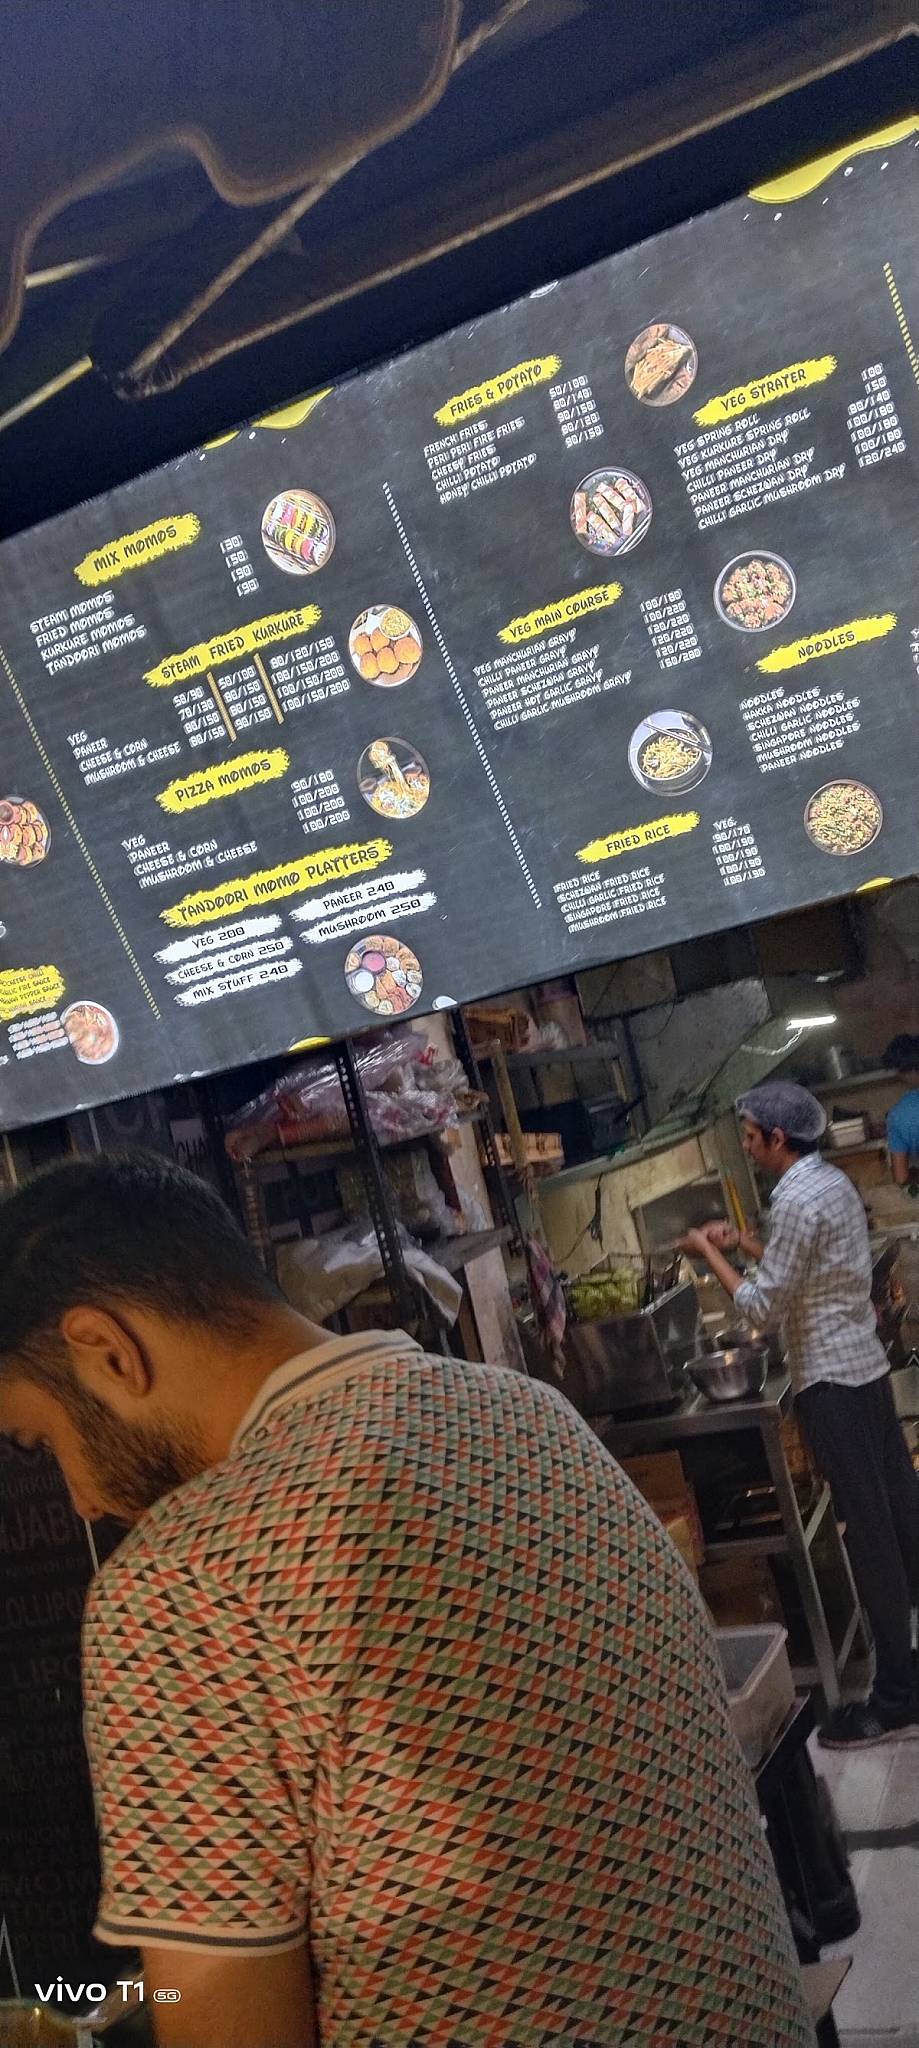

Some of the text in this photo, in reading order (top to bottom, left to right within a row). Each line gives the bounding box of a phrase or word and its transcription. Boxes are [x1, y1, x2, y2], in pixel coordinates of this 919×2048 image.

[721, 369, 806, 411] VEG STRATER
[861, 362, 883, 381] 100
[863, 375, 887, 394] 150
[450, 365, 541, 416] FRIES & POTATO
[423, 419, 488, 458] FRENCH FRIES
[427, 416, 525, 469] PERI PERI FIRE FRIES
[673, 413, 760, 456] VEG SPRING ROLL
[677, 407, 811, 469] VEG KURKURE SPRING ROLL
[430, 443, 496, 481] CHEESY FRIES
[681, 428, 789, 481] VEG MANCHURIAN DRY
[686, 447, 777, 493] CHILLI PANEER DRY
[856, 439, 906, 468] 120/240
[435, 456, 500, 492] CHILLI POTATO
[440, 453, 537, 504] HONEY CHILLI POTATO
[690, 446, 815, 506] PANEER MANCHURIAN DRY
[698, 462, 846, 530] CHILLI GARLIC MUSHROOM DRY
[94, 525, 176, 572] MIX MOMOS
[220, 534, 243, 554] 130
[225, 549, 248, 568] 150
[231, 563, 253, 582] 190
[236, 578, 259, 596] 190
[30, 590, 114, 634] STEAM MOMOS
[35, 606, 115, 648] FRIED MOMOS
[509, 590, 609, 637] VEG MAIN COURSE
[641, 600, 686, 624] 100/220
[647, 612, 690, 635] 120/220
[40, 614, 135, 661] KURKURE MOMOS
[45, 624, 147, 676] TANDOORI MOMOS
[161, 613, 304, 678] STEAM FRIED KURKURE
[472, 627, 576, 676] VEG MANCHURIAN GRAVY
[651, 623, 694, 647] 120/220
[655, 634, 698, 658] 120/220
[798, 631, 854, 658] NOODLES
[271, 650, 340, 685] 100/150/200
[276, 664, 345, 699] 100/150/200
[478, 644, 567, 687] CHILLI PANEER GRAVY
[481, 644, 599, 698] PANEER MANCHURIAN GRAVY
[281, 678, 351, 713] 100/150/200
[494, 670, 632, 730] CHILLI GARLIC MUSHROOM GRAVY
[739, 686, 785, 711] NOODLES
[742, 686, 821, 721] HAKKA NOODLES
[749, 696, 860, 742] CHILLI GARLIC NOODLES
[752, 710, 855, 752] SINGAPORE NOODLES
[66, 730, 88, 747] VEG
[72, 737, 108, 759] PANEER
[79, 738, 148, 772] CHEESE & CORN
[756, 720, 861, 763] MUSHROOM NOODLES
[84, 741, 181, 786] MUSHROOM & CHEESE
[175, 759, 271, 802] PIZZA MOMOS
[292, 782, 340, 808] 100/200
[297, 795, 345, 821] 100/200
[302, 809, 350, 834] 100/200
[606, 824, 670, 852] FRIED RICE
[121, 834, 146, 851] VEG
[127, 841, 170, 864] PANEER
[134, 839, 218, 876] CHEESE & CORN
[139, 840, 258, 889] MUSHROOM & CHEESE
[177, 846, 379, 920] TANDOORI MOMO PLATTERS
[552, 870, 600, 893] FRIED RICE
[322, 881, 395, 910] PANEER 240
[557, 866, 650, 903] SCHEZWAN FRIED RICE
[560, 873, 665, 913] CHILLI GARLIC FRIED RICE
[318, 899, 421, 937] MUSHROOM 250
[192, 926, 245, 948] VEG 200
[178, 941, 284, 979] CHEESE & CORN 250
[193, 965, 288, 999] MIX STUFF 240
